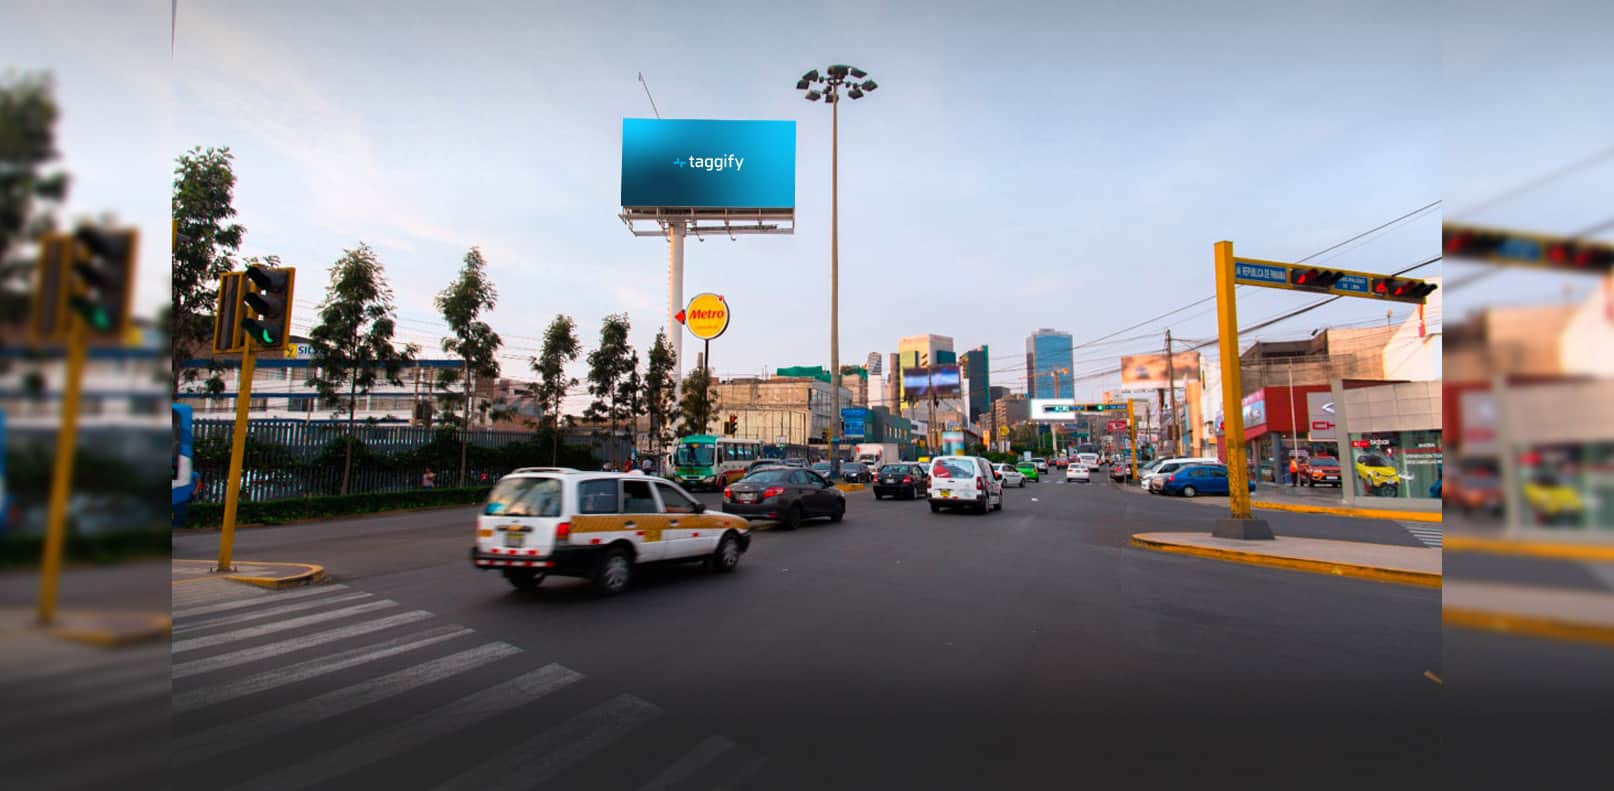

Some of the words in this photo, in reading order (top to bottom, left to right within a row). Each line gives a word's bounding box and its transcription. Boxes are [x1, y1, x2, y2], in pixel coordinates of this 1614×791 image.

[689, 153, 744, 171] taggify
[690, 309, 724, 320] Metro
[1312, 421, 1336, 430] CH
